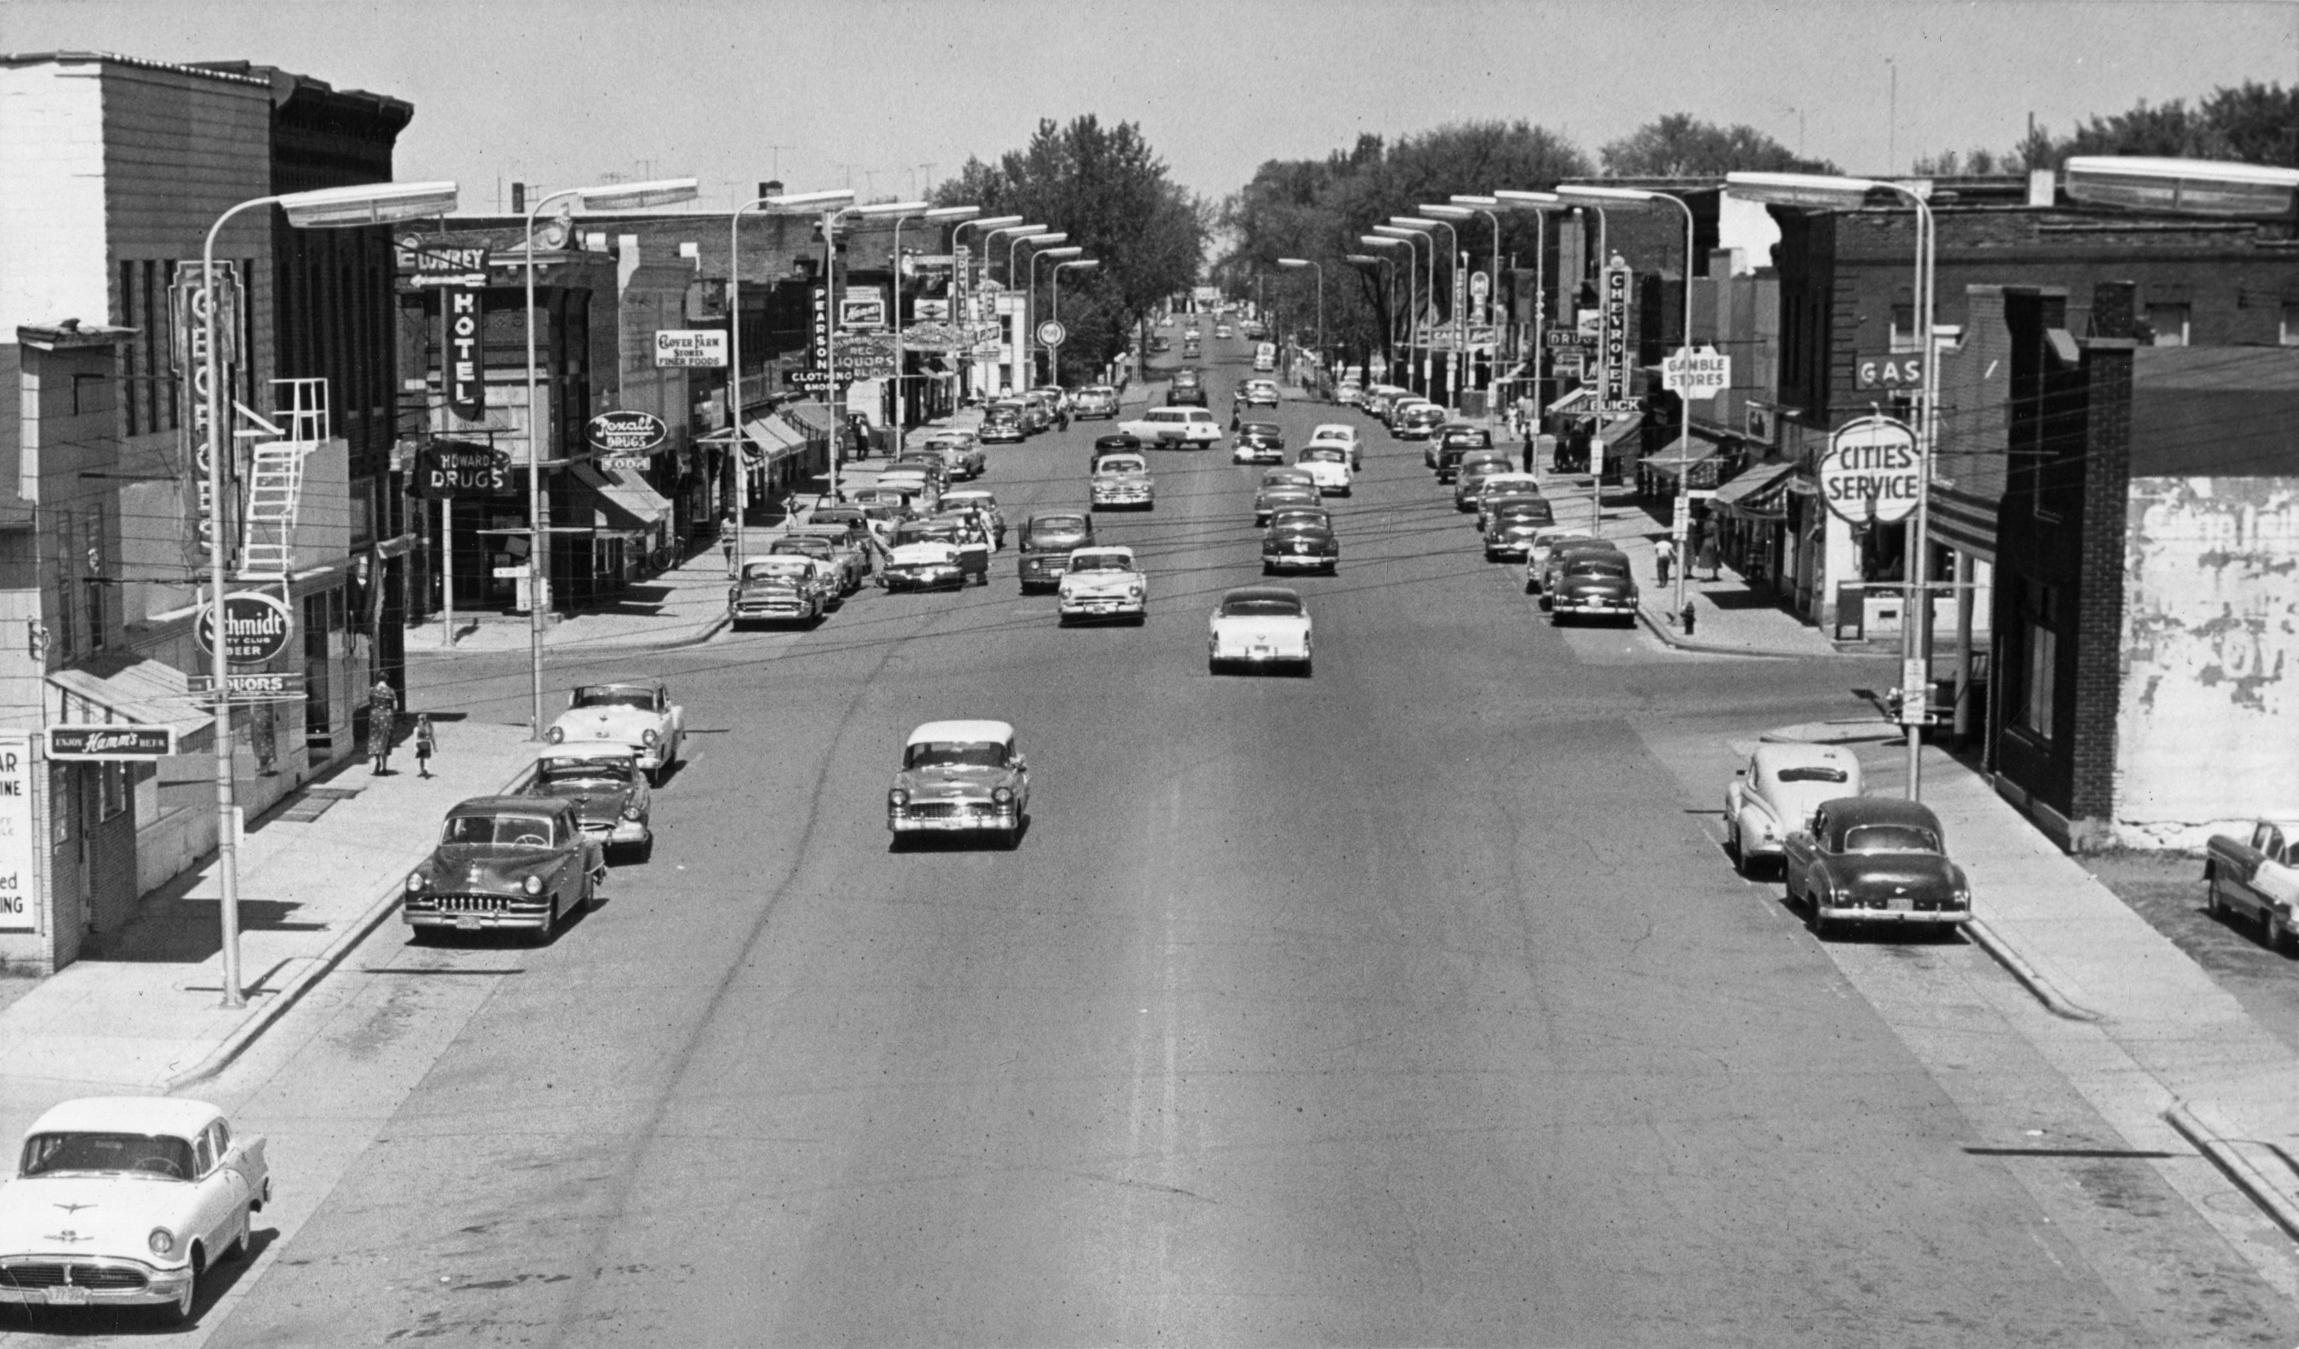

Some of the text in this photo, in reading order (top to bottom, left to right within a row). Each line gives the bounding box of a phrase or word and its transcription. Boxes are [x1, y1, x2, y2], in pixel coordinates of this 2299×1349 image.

[418, 249, 484, 270] LOWREY
[815, 289, 827, 369] PEARSON
[1610, 275, 1622, 392] CHEVROLET
[695, 334, 719, 349] FARM
[1550, 334, 1600, 345] DRU
[454, 294, 475, 404] HOTEL
[659, 357, 720, 366] FINER FOODS
[1668, 359, 1724, 372] GAMBLE
[791, 372, 853, 382] CLOTHNG
[1669, 373, 1724, 386] STORES
[1861, 361, 1920, 383] GAS
[606, 436, 646, 447] DRUGS
[440, 454, 490, 469] HOWARD
[1840, 445, 1912, 470] CITIES
[431, 470, 503, 488] DRUGS
[1828, 475, 1918, 501] SERVICE
[205, 607, 283, 640] Shmidt
[225, 646, 261, 656] BEER
[206, 678, 283, 692] LQUORS
[55, 732, 165, 753] ENJOY Hamm's BEER
